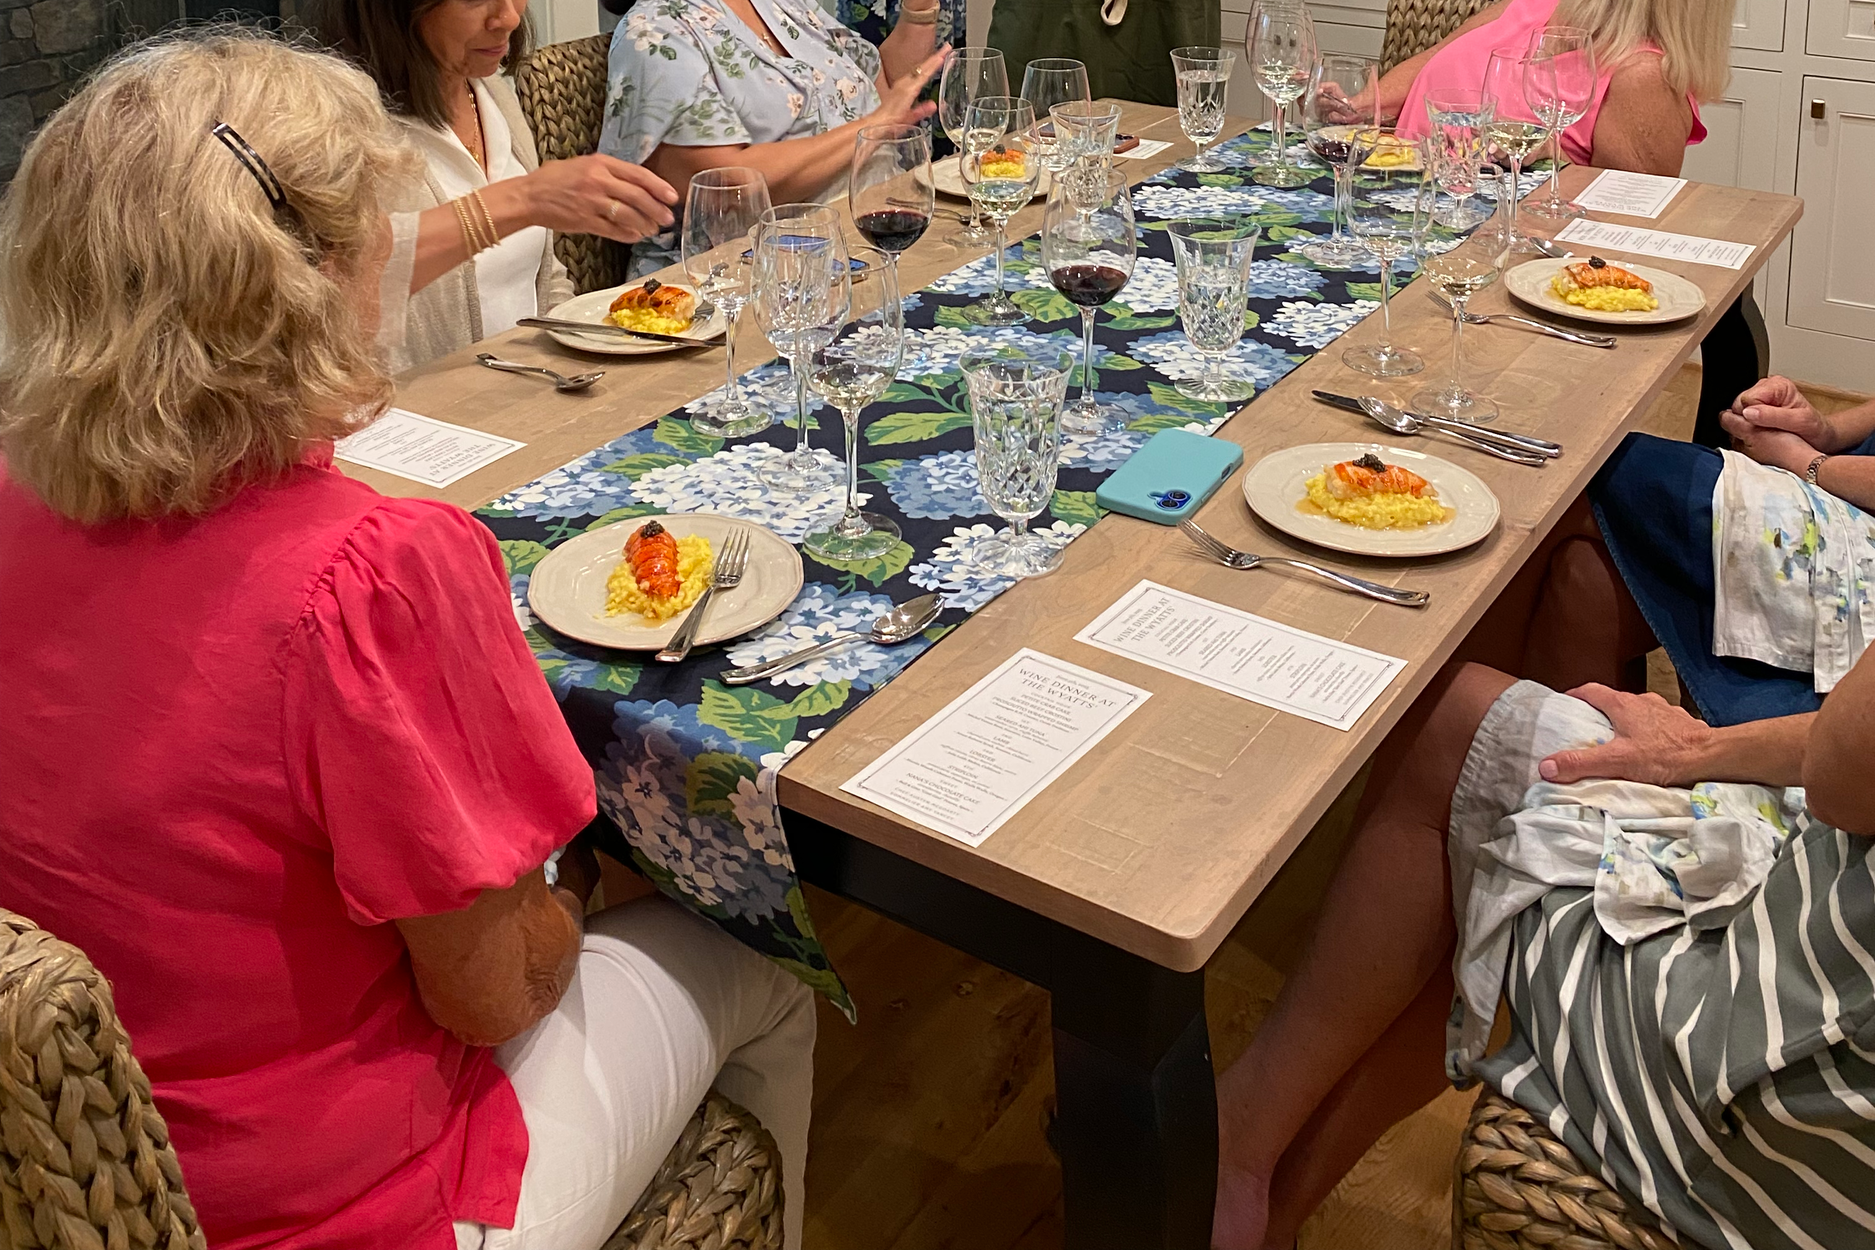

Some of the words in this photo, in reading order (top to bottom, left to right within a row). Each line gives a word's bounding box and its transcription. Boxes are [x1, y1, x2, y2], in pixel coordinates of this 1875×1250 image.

[1113, 626, 1136, 642] WINE
[1131, 604, 1162, 627] DINNER
[1155, 597, 1171, 606] AT
[1129, 629, 1150, 642] THE
[1016, 668, 1051, 683] WINE
[1050, 680, 1099, 700] DINNER
[1097, 697, 1117, 707] AT
[1018, 678, 1046, 690] THE
[1044, 687, 1099, 710] WYATTS'
